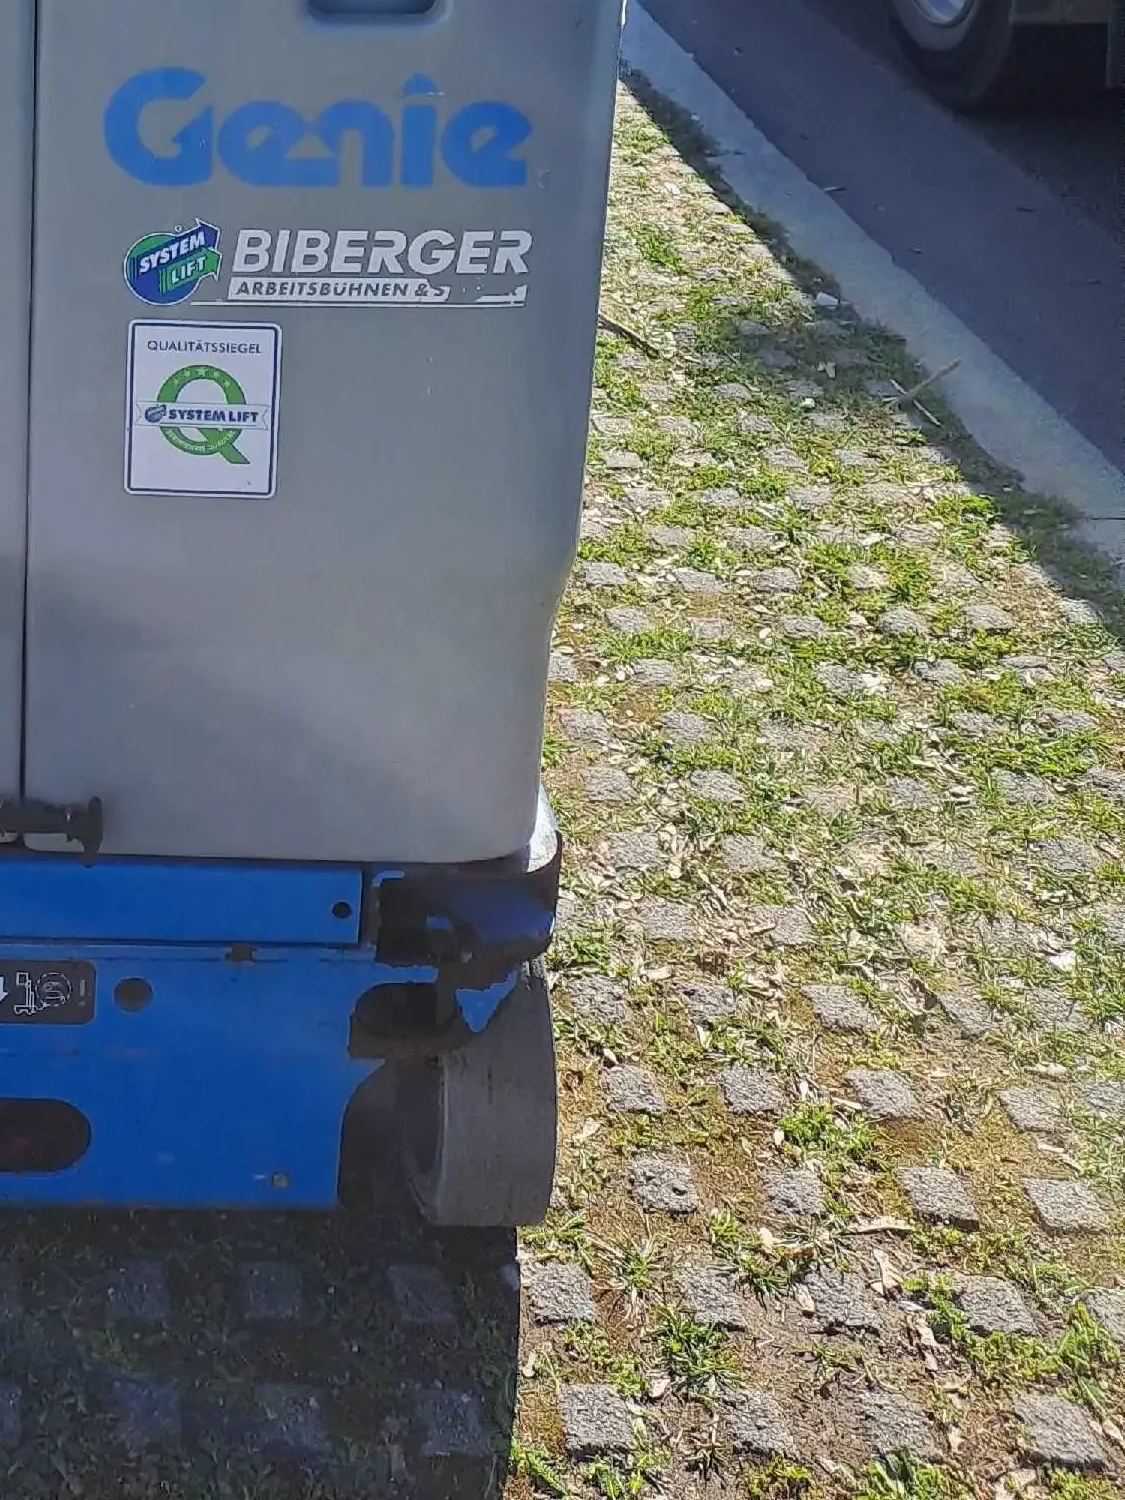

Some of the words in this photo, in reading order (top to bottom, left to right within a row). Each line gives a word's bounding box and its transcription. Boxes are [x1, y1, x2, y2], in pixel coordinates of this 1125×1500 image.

[102, 66, 533, 188] Genie
[138, 230, 206, 276] SYSTEM
[231, 228, 534, 275] BIBERGER
[171, 256, 207, 284] LIFT
[235, 280, 409, 298] ARBEITSBÜHNEN
[414, 281, 429, 297] &
[146, 339, 263, 355] QUALITÄTSSIEGEL
[168, 408, 226, 422] SYSTEM
[227, 410, 260, 423] LIFT
